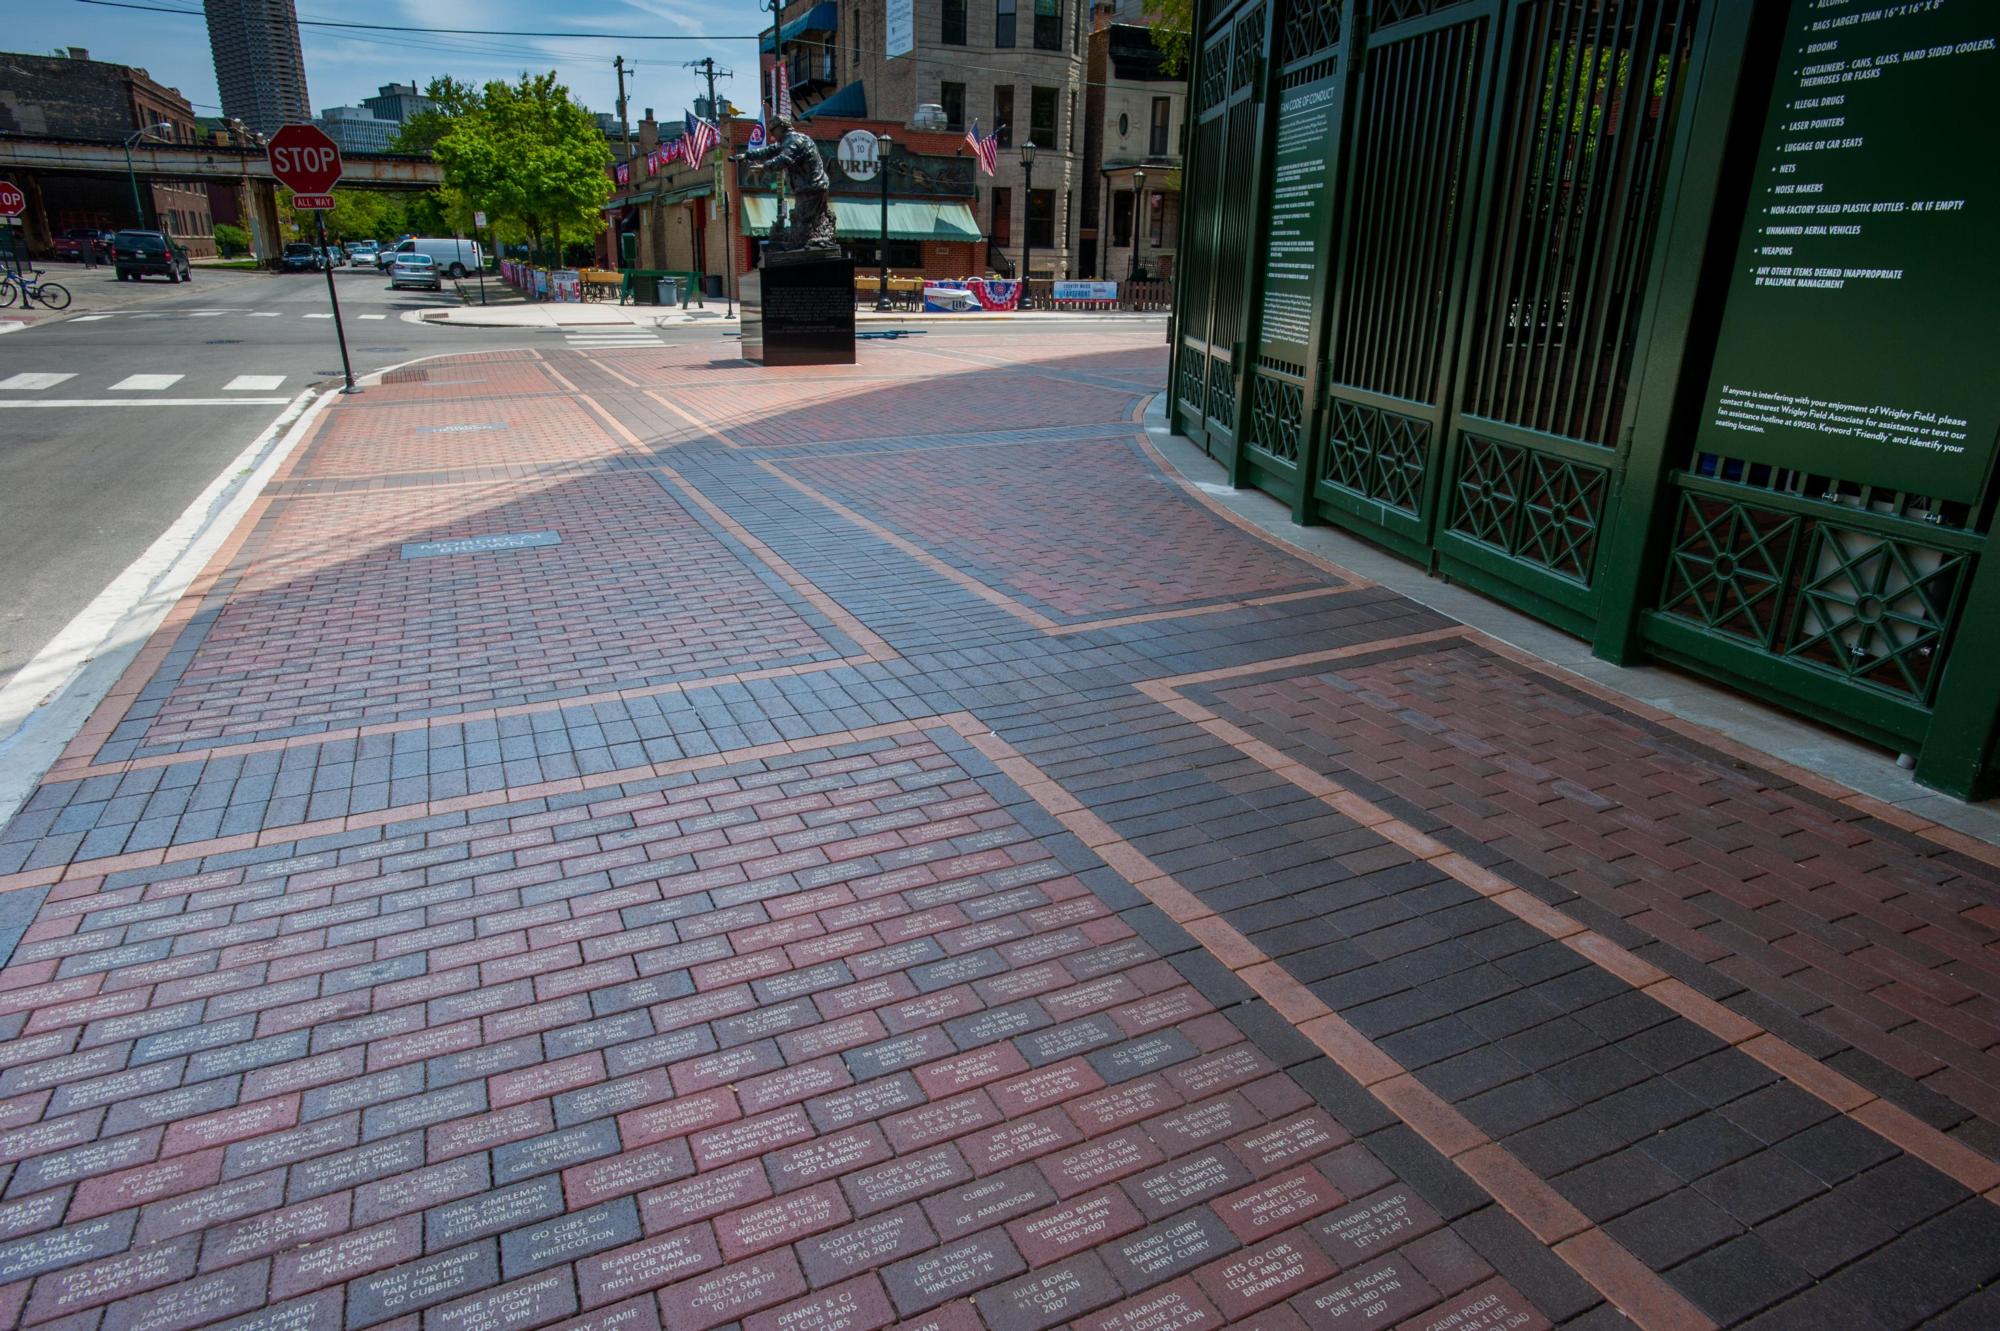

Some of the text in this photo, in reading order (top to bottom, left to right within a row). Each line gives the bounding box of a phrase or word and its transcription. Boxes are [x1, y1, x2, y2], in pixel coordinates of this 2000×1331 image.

[1817, 0, 1850, 8] ALCOH
[1812, 0, 1945, 31] BAGS LARGER THAN 16" X 16" X 8"
[1801, 61, 1846, 76] CONTAINERS
[1851, 57, 1873, 69] CANS,
[1875, 53, 1900, 66] GLASS,
[1902, 50, 1926, 62] HARD
[1927, 46, 1953, 58] SIDED
[1955, 39, 1996, 54] COOLERS,
[1806, 41, 1838, 54] BROOMS
[1800, 68, 1881, 88] THERMOSES OR FLASKS
[1309, 86, 1335, 104] CONDUCT
[1794, 95, 1845, 110] ILLEGAL DRUGS
[1788, 117, 1845, 131] LASER POINTERS
[857, 145, 865, 153] 10
[1784, 138, 1863, 153] LUGGAGE OR CAR SEATS
[274, 147, 335, 173] STOP
[1779, 163, 1797, 174] NETS
[1774, 183, 1824, 194] NOISE MAKERS
[297, 198, 331, 207] ALL WAY
[1770, 205, 1816, 215] NON-FACTORY
[1815, 204, 1841, 214] SEALED
[1842, 203, 1872, 213] PLASTIC
[1872, 202, 1905, 213] BOTTLES
[1911, 201, 1924, 211] OK
[1925, 201, 1934, 211] IF
[1934, 200, 1965, 211] EMPTY
[1766, 225, 1861, 235] UNMANNED AERIAL VEHICLES
[1761, 246, 1793, 256] WEAPONS
[1756, 266, 1903, 279] ANY OTHER ITEMS DEEMED INAPPROPRIATE
[1755, 277, 1845, 289] BY BALLPARK MANAGEMENT
[1722, 385, 1967, 427] If anyone is interfering with your enjoyment of Wrigley Field, please
[1715, 419, 1765, 433] seating location.
[1719, 398, 1744, 407] contact
[1743, 399, 1755, 409] the
[1755, 403, 1780, 413] nearest
[1781, 404, 1809, 419] Wrigley
[1808, 408, 1828, 420] Field
[1827, 412, 1865, 425] Associate
[1865, 417, 1878, 427] for
[1877, 421, 1920, 433] assistance
[1931, 428, 1950, 438] text
[1950, 432, 1967, 440] our
[1717, 406, 1729, 416] fan
[1728, 410, 1760, 421] assistance
[1760, 413, 1784, 425] hotline
[1792, 420, 1817, 431] 69050,
[1818, 422, 1853, 436] Keyword
[1853, 428, 1892, 443] "Friendly"
[1891, 435, 1909, 445] and
[1909, 437, 1943, 452] identify
[1942, 444, 1965, 453] your
[1231, 1175, 1306, 1211] HAPPY BIRTHDAY
[1251, 1189, 1307, 1215] ANGELO LES
[1252, 1193, 1318, 1226] GO CUBS 2007
[1322, 1195, 1407, 1234] RAYMOND BARNES
[531, 1230, 550, 1241] GO
[553, 1221, 584, 1234] CUBS
[554, 1227, 589, 1244] STEVE
[1122, 1220, 1198, 1257] BUFORD CURRY
[1339, 1221, 1375, 1241] PUDGIE
[1354, 1217, 1413, 1248] LET'S PLAY 2
[531, 1230, 615, 1261] WHITECOTTON
[1129, 1229, 1206, 1266] HARVEY CURRY
[1140, 1239, 1210, 1274] LARRY CURRY
[691, 1272, 776, 1308] CHOLLY SMITH
[698, 1266, 760, 1294] MELISSA &
[1314, 1266, 1397, 1309] BONNIE PAGANIS
[711, 1289, 762, 1312] 10/14/06
[1330, 1280, 1401, 1317] DIE HARD FAN
[1365, 1299, 1388, 1318] 2007
